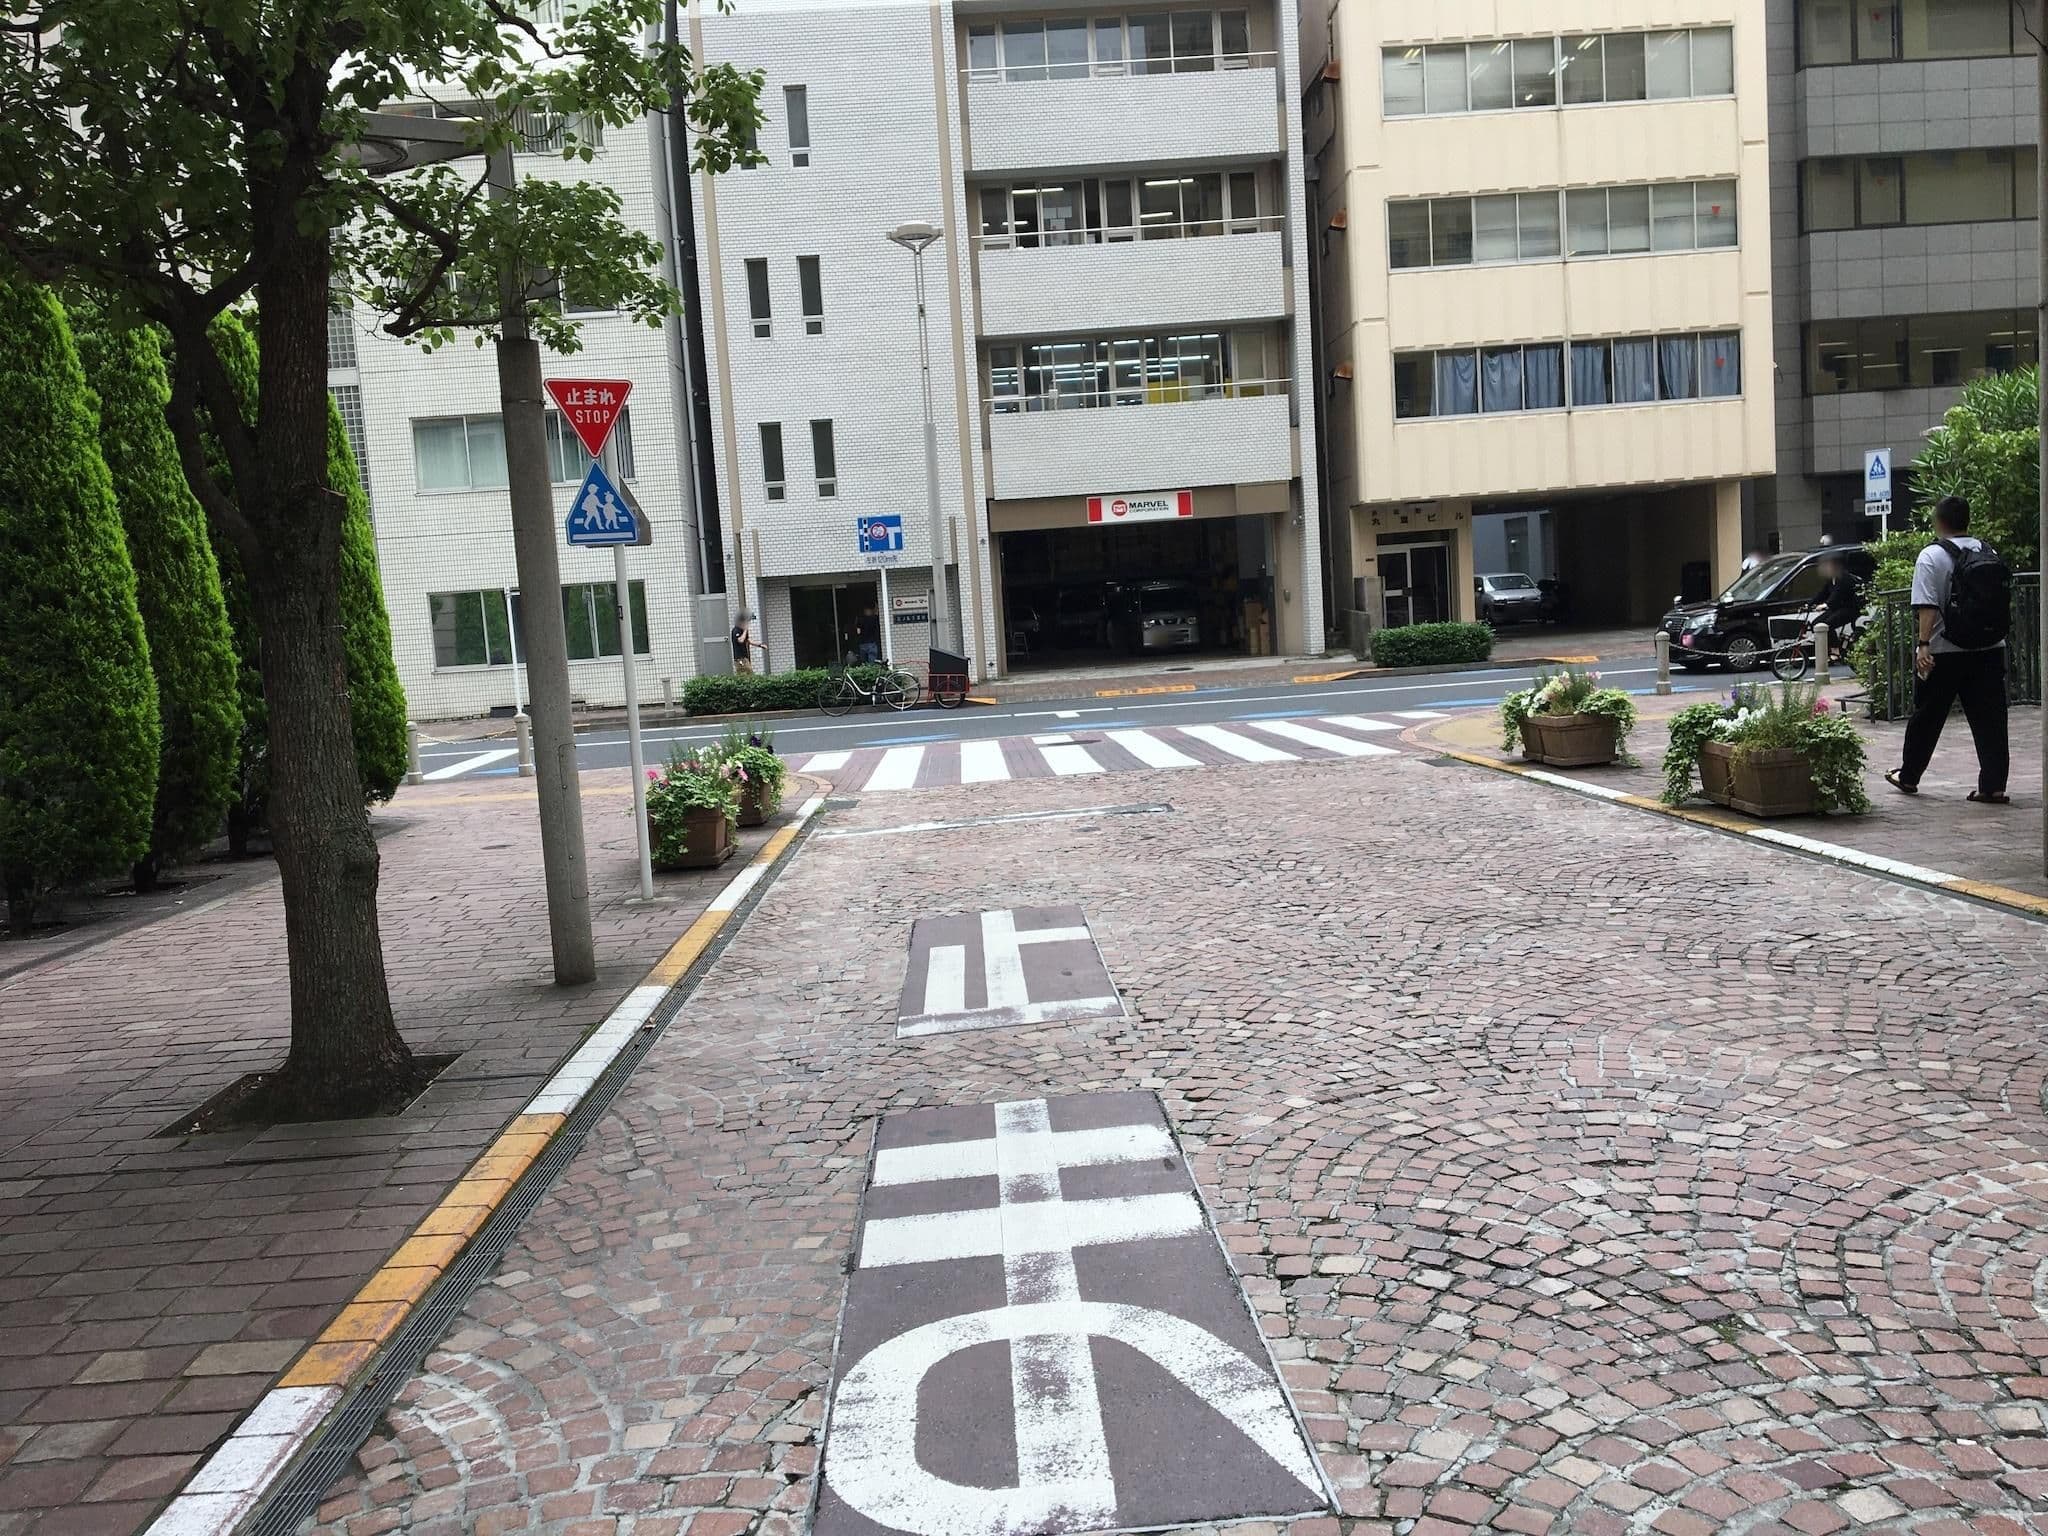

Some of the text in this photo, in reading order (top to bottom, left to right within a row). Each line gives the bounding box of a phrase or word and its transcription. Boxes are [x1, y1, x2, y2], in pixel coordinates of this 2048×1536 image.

[566, 387, 617, 405] 止まれ
[575, 409, 610, 424] STOP
[1128, 500, 1169, 509] MARVEL
